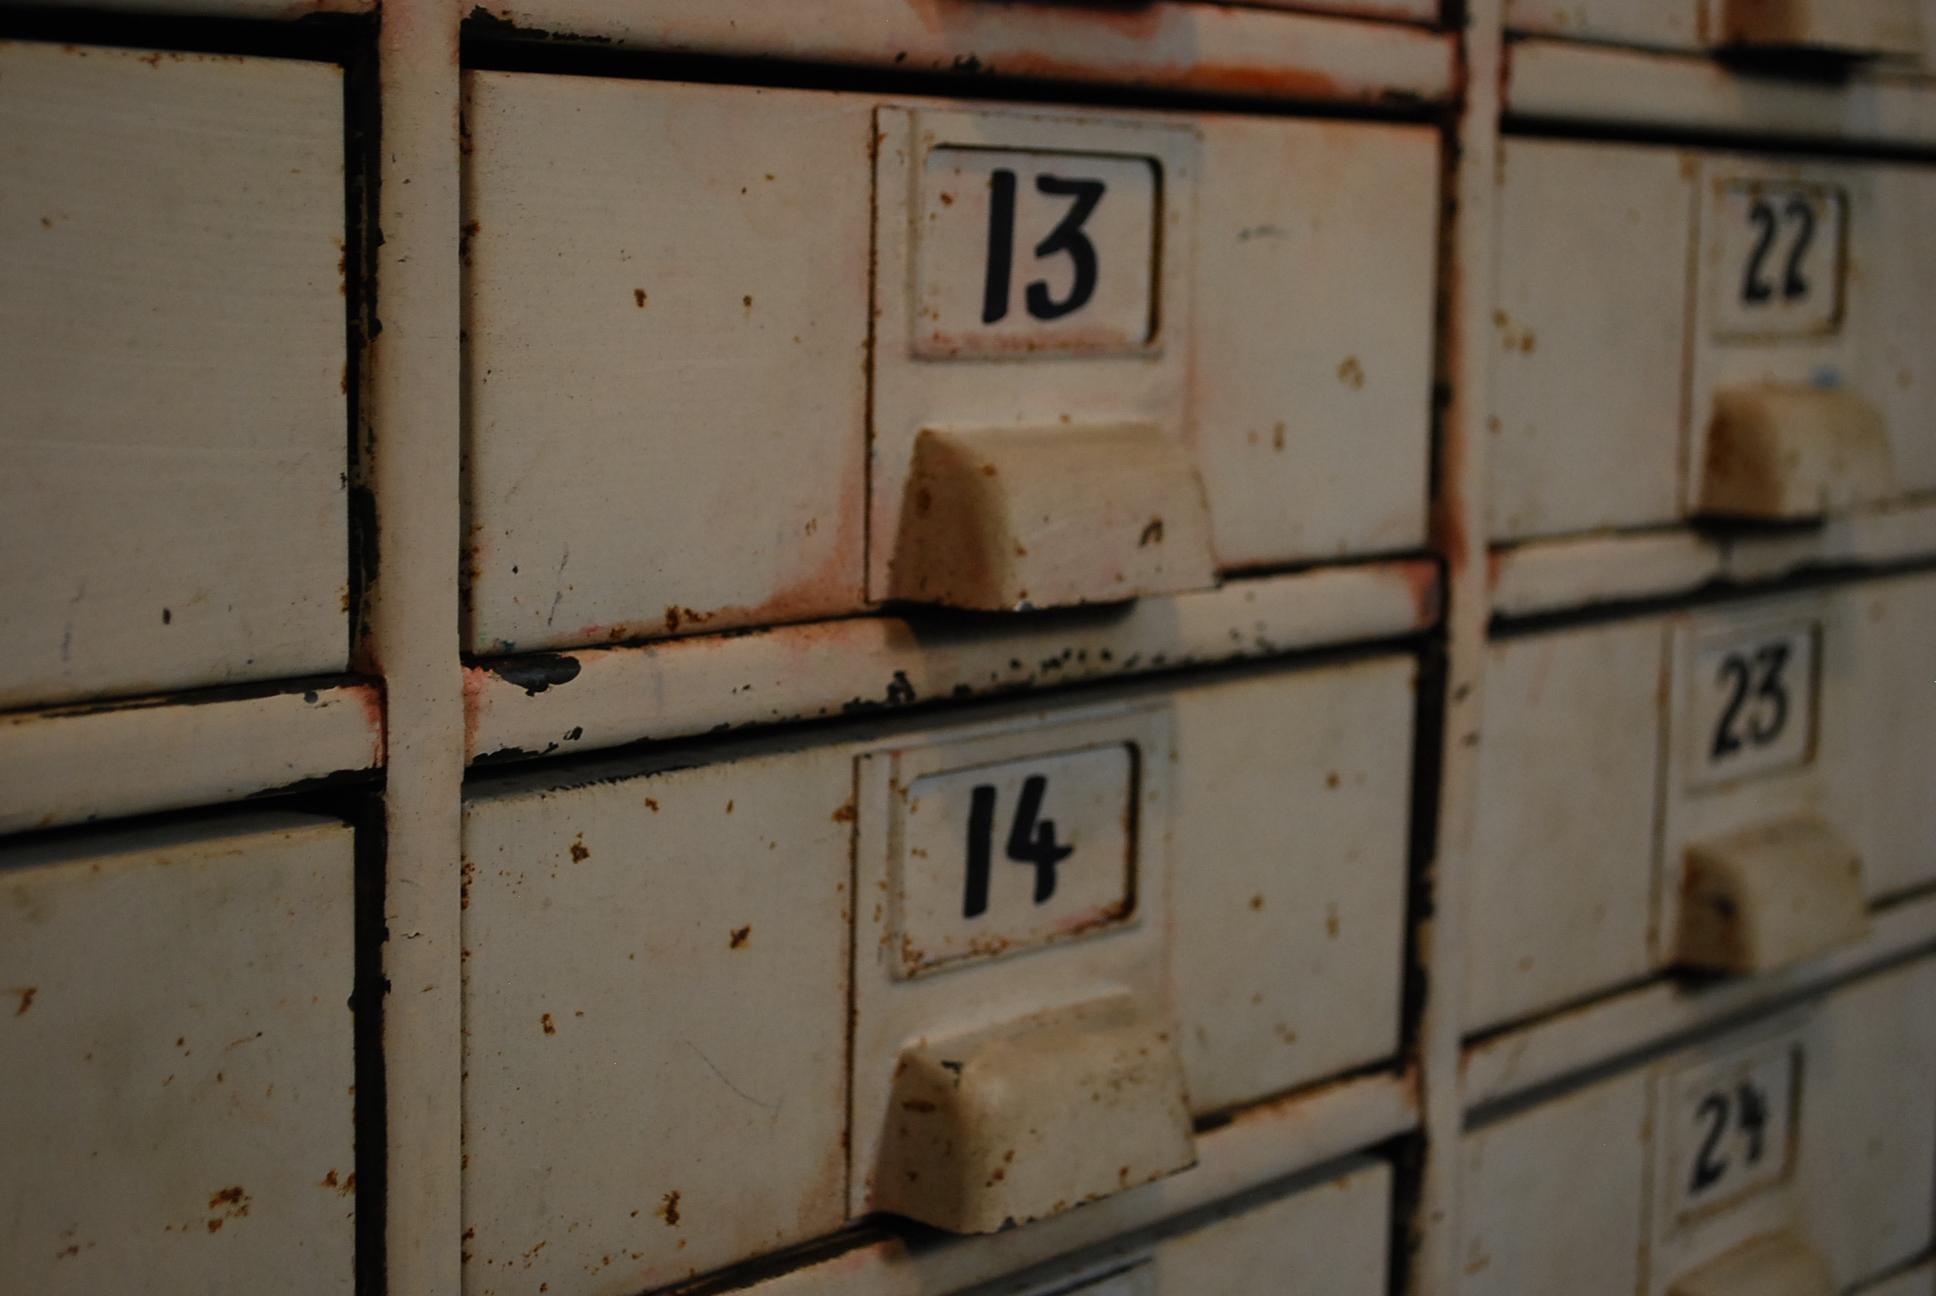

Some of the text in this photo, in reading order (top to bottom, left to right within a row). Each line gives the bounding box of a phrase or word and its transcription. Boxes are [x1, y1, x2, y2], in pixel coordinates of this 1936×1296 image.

[982, 169, 1105, 324] 13
[1742, 200, 1815, 303] 22
[1710, 642, 1790, 759] 23
[963, 774, 1074, 918] 14
[1688, 1083, 1767, 1195] 24
